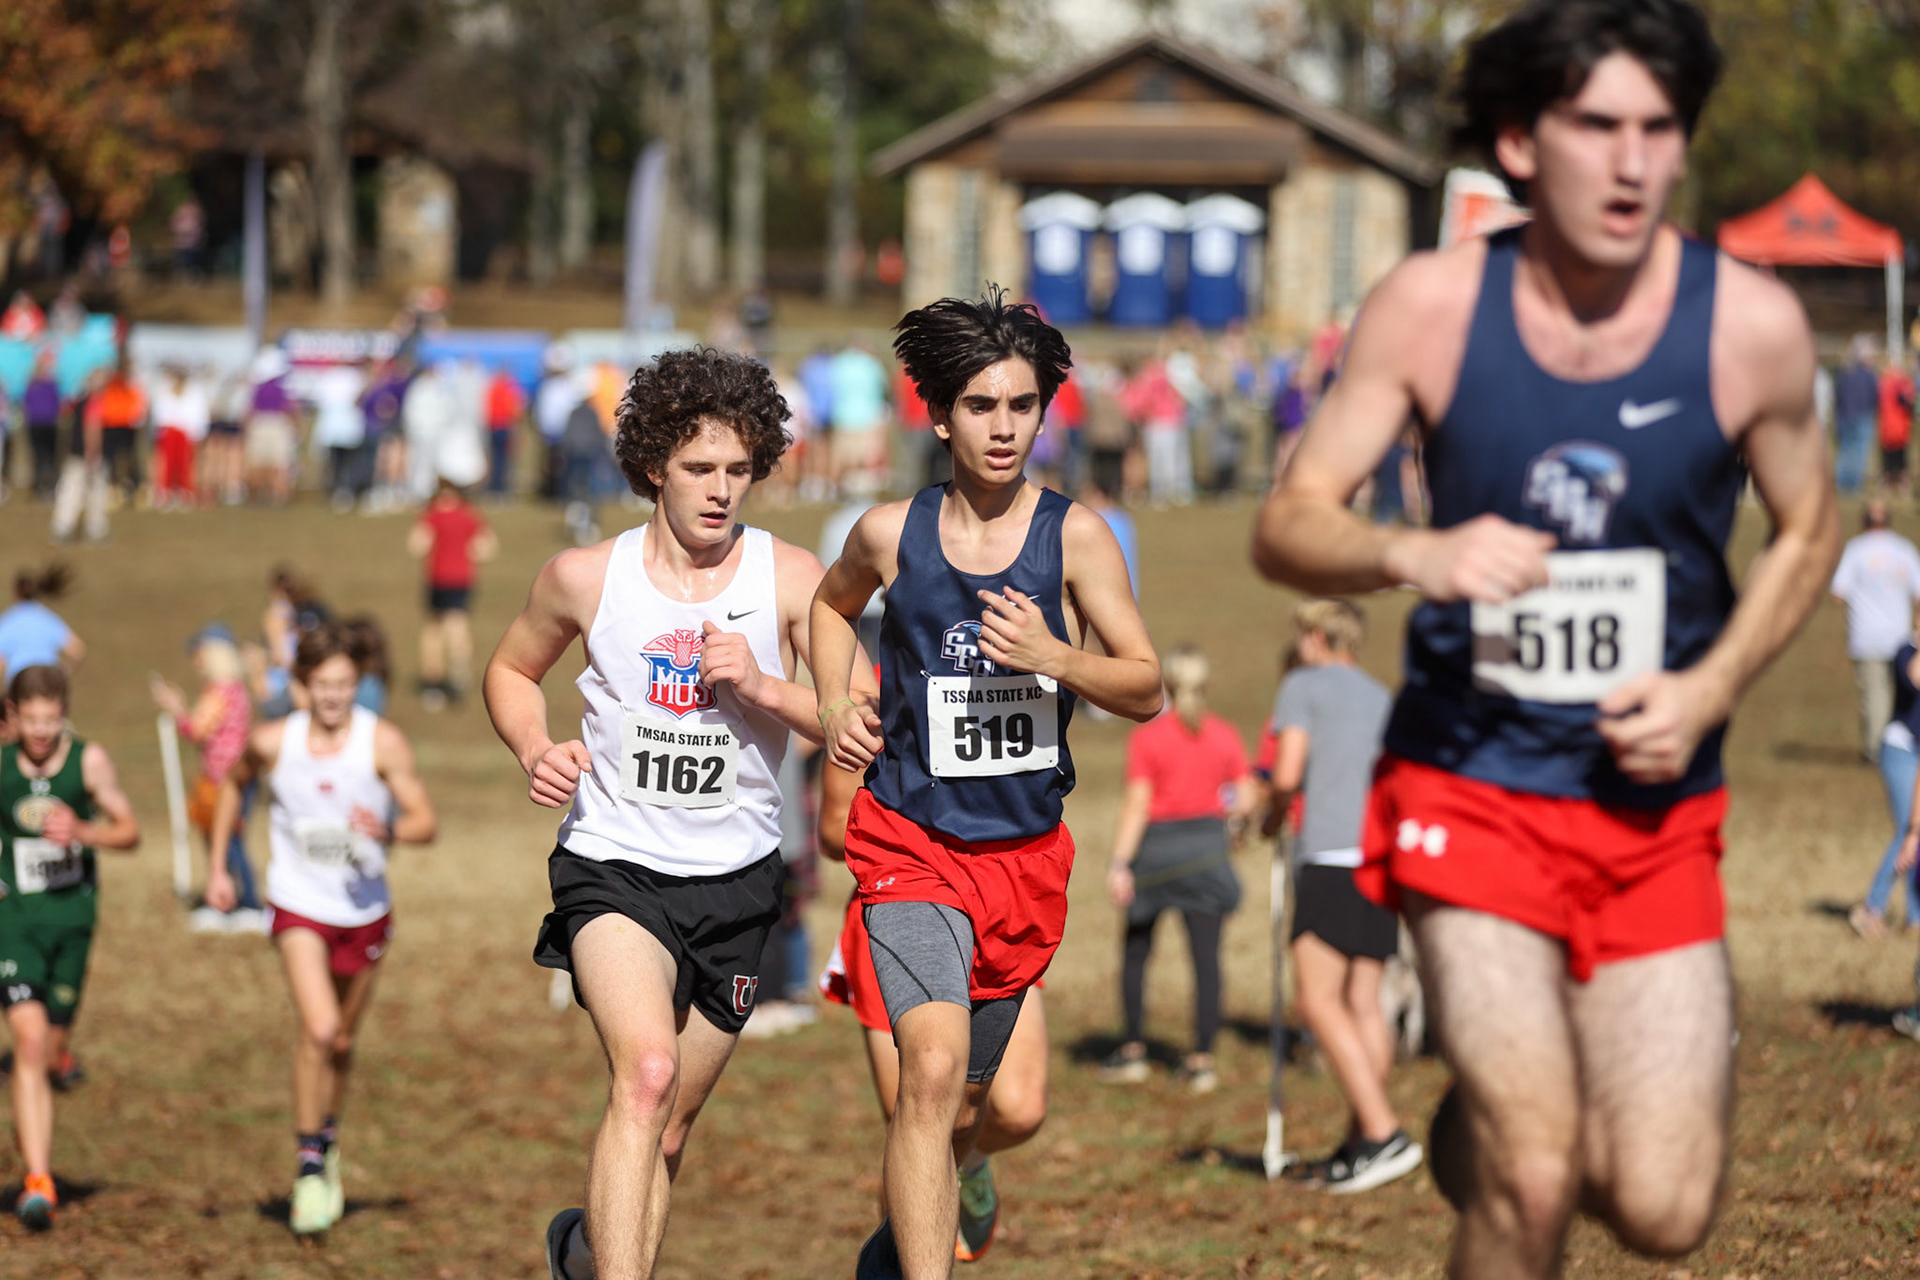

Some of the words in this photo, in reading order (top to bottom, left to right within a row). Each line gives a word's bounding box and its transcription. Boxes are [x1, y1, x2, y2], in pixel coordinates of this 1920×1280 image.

[1514, 613, 1620, 673] 518
[656, 664, 710, 708] MUS
[942, 689, 984, 704] TSSAA
[986, 687, 1024, 703] STATE
[1026, 686, 1043, 700] XC
[636, 725, 676, 744] TMSAA
[678, 733, 712, 746] STATE
[714, 734, 730, 746] XC
[954, 712, 1034, 762] 519
[632, 750, 725, 795] 1162
